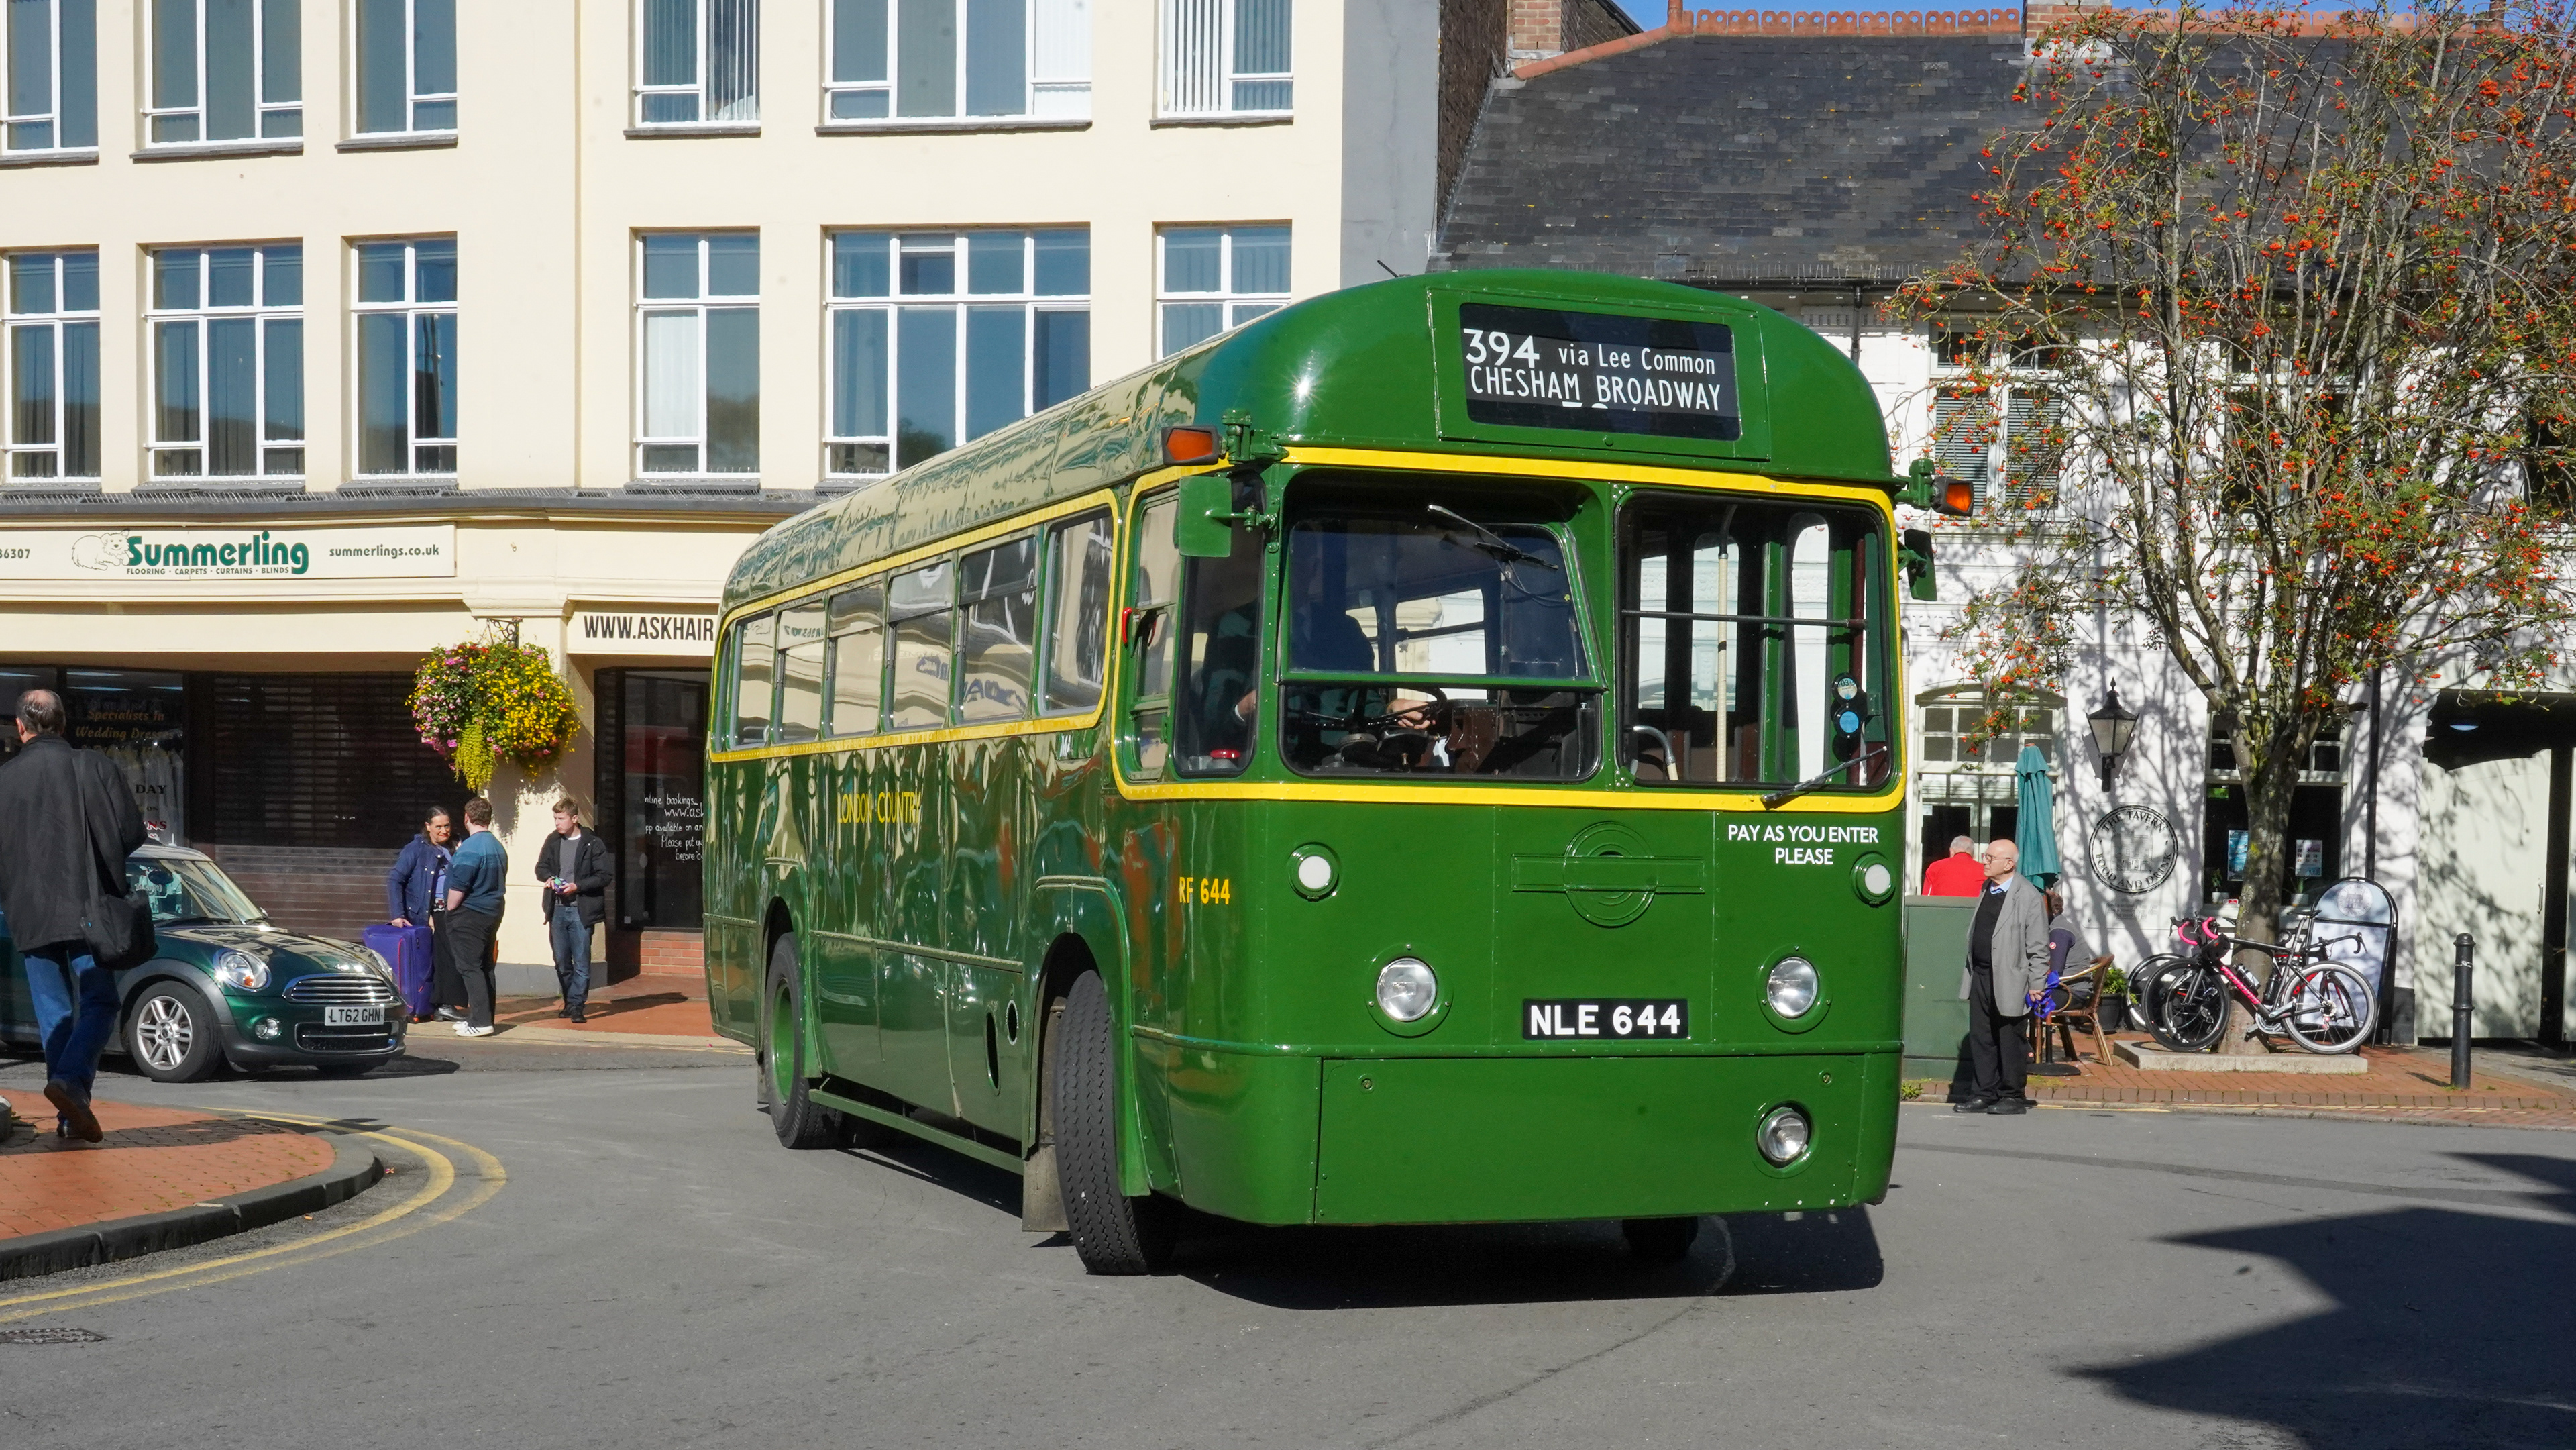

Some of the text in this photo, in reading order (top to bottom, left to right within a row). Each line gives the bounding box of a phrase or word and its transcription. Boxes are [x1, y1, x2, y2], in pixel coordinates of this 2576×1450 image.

[1463, 328, 1715, 374] 394 via Lee Common
[1471, 366, 1721, 411] CHESHAM BROADWAY
[127, 530, 309, 575] Summerling
[329, 544, 439, 559] summerlings.co.uk
[584, 615, 714, 641] WWW.ASKHAIR
[88, 709, 149, 721] Specialists
[76, 726, 127, 741] Wedding
[136, 784, 166, 794] DAY
[837, 792, 921, 823] LONDON COUNTRY
[143, 821, 167, 831] NS
[655, 822, 682, 832] available
[2102, 811, 2166, 833] THE TAVERN
[661, 835, 682, 847] Please
[1728, 824, 1879, 843] PAY AS YOU ENTER
[1775, 847, 1833, 865] PLEASE
[2096, 852, 2172, 889] FOOD AND DRINK
[1179, 876, 1230, 904] RF 644
[331, 1008, 380, 1023] LT62 GHN
[1530, 1004, 1680, 1035] NLE 644
